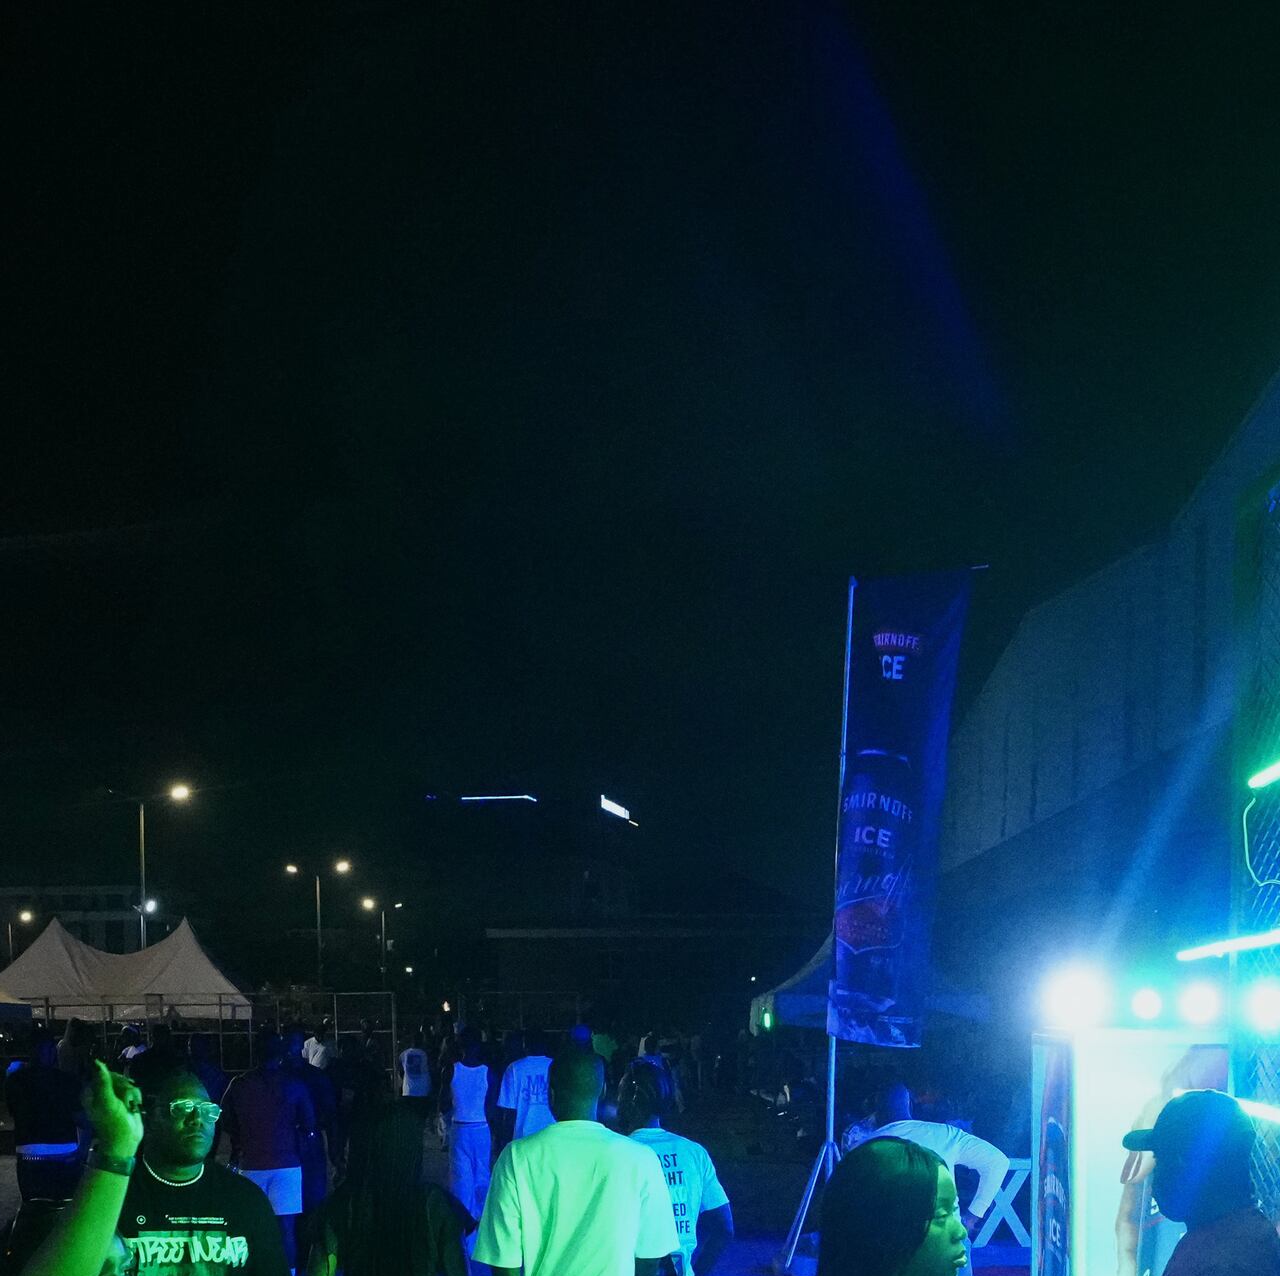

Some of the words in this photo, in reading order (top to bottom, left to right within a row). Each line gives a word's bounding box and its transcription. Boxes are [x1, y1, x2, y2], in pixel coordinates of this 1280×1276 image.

[879, 654, 905, 680] CE
[854, 826, 892, 848] ICE
[1049, 1218, 1061, 1247] ICE
